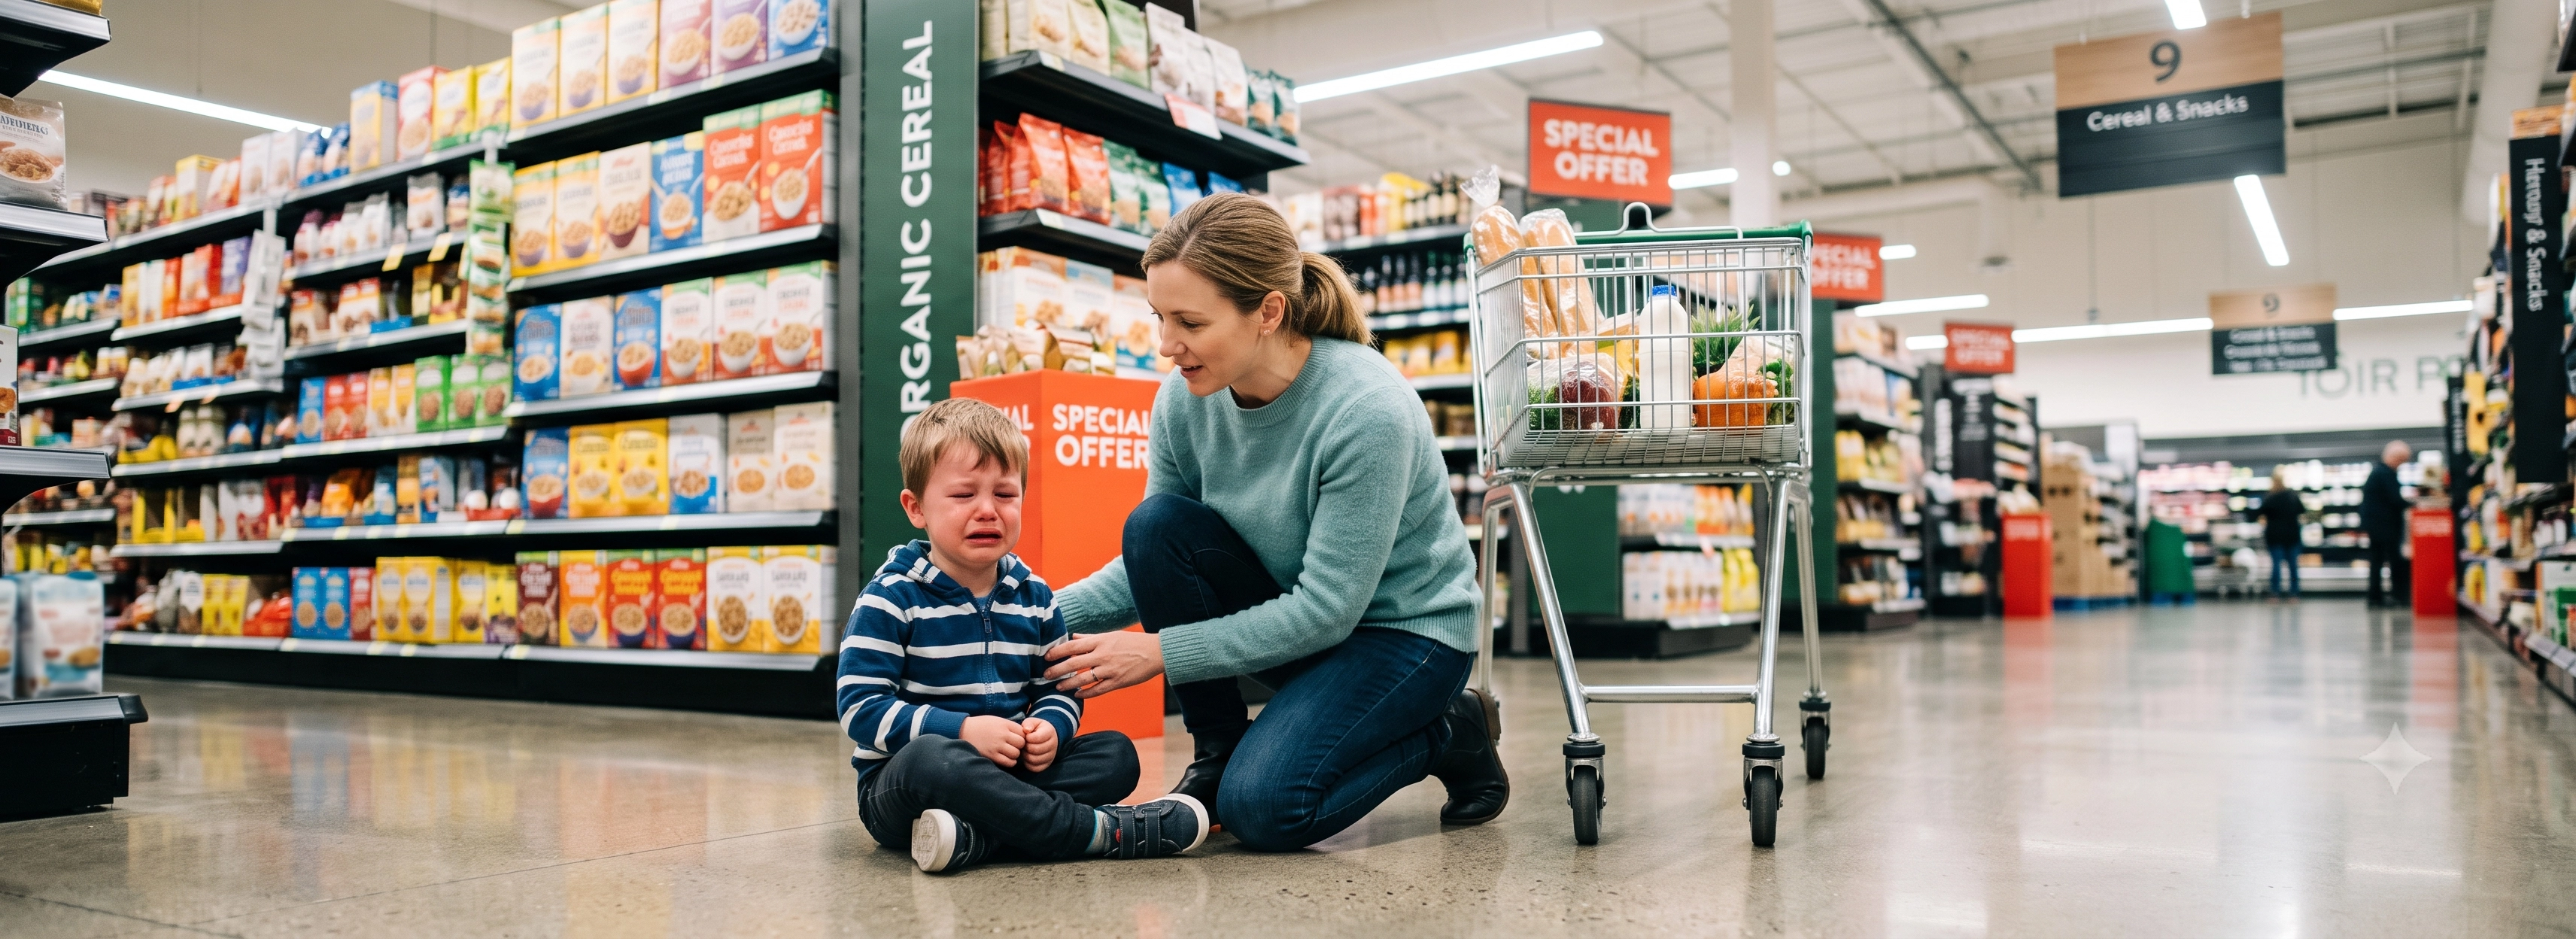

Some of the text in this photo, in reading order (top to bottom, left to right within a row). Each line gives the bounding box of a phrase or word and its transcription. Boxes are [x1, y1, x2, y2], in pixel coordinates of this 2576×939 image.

[2150, 40, 2181, 84] 9
[901, 20, 933, 208] CEREAL
[2086, 93, 2249, 132] Cereal & Snacks
[1544, 118, 1660, 157] SPECIAL
[1554, 150, 1648, 187] OFFER
[2525, 228, 2547, 245] &
